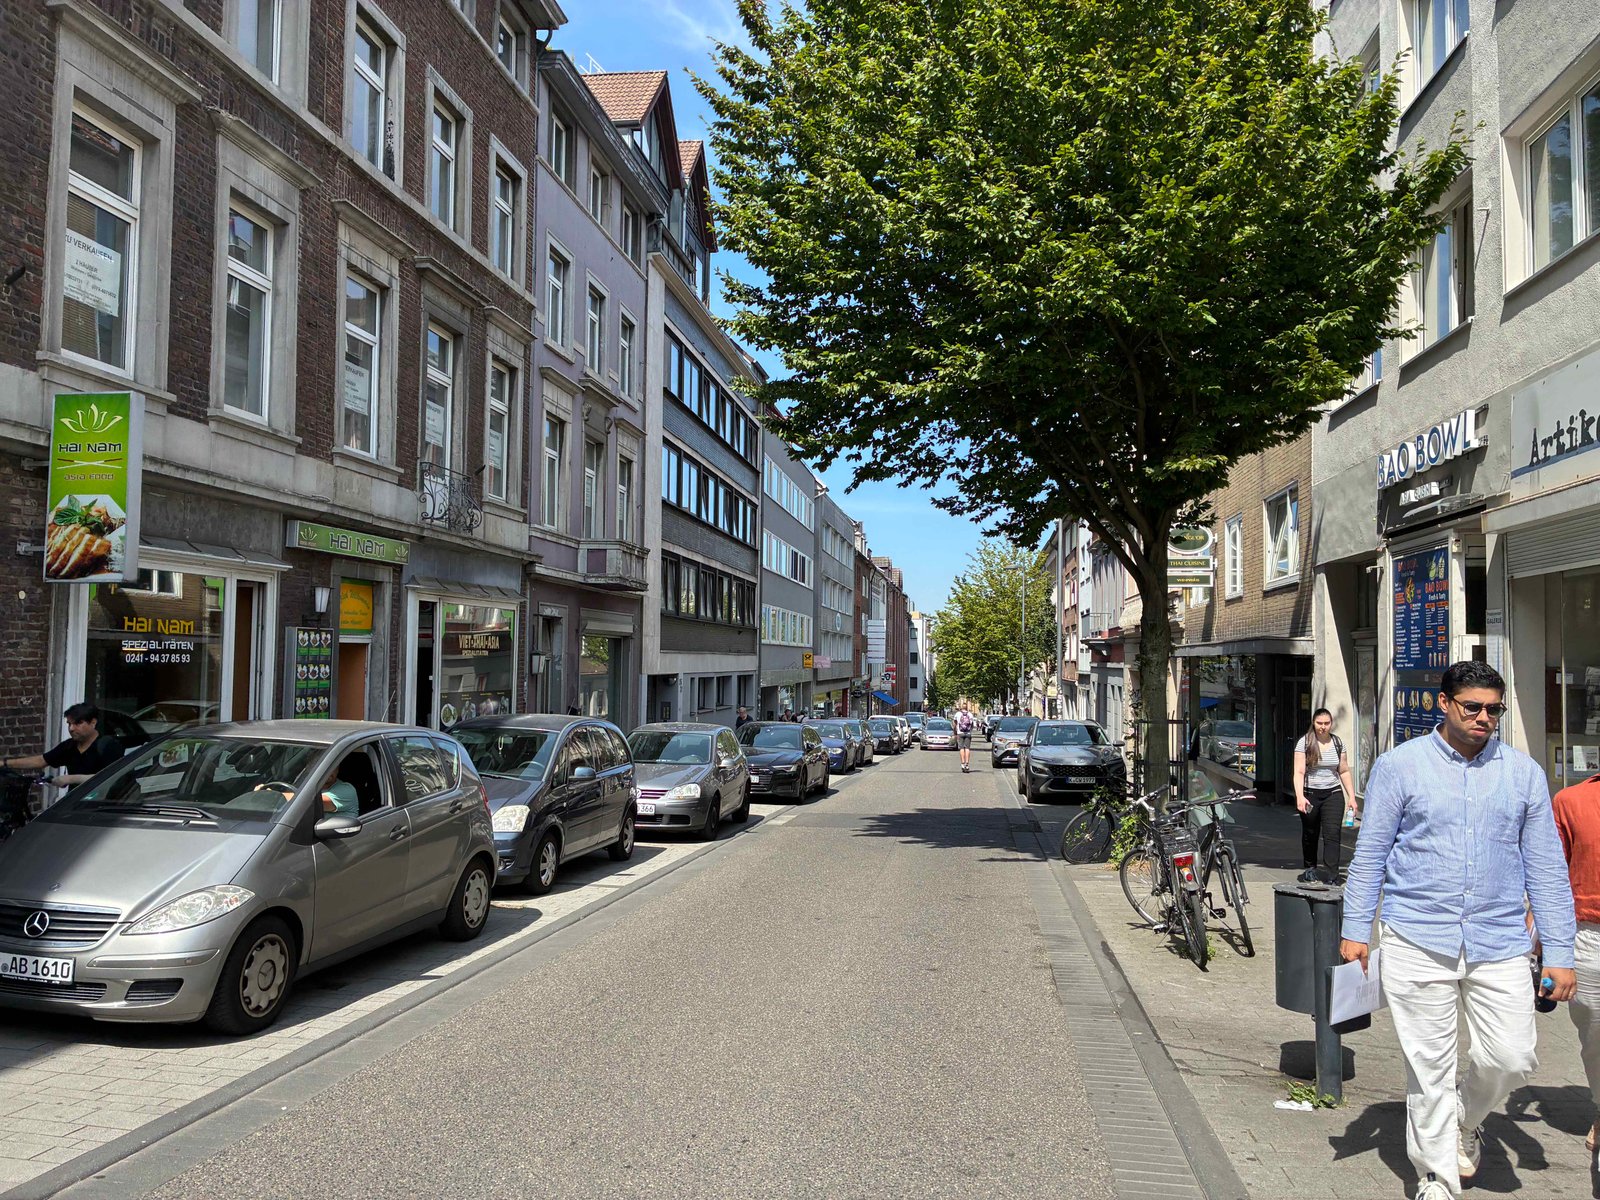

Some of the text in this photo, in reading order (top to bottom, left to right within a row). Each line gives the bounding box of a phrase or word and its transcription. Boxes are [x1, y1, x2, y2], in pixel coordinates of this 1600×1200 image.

[1377, 410, 1476, 489] BAO BOWL
[126, 654, 143, 662] 0241
[150, 654, 159, 662] 94
[161, 654, 169, 662] 37
[171, 654, 180, 662] 85
[182, 654, 190, 662] 93
[9, 957, 70, 979] AB 1610
